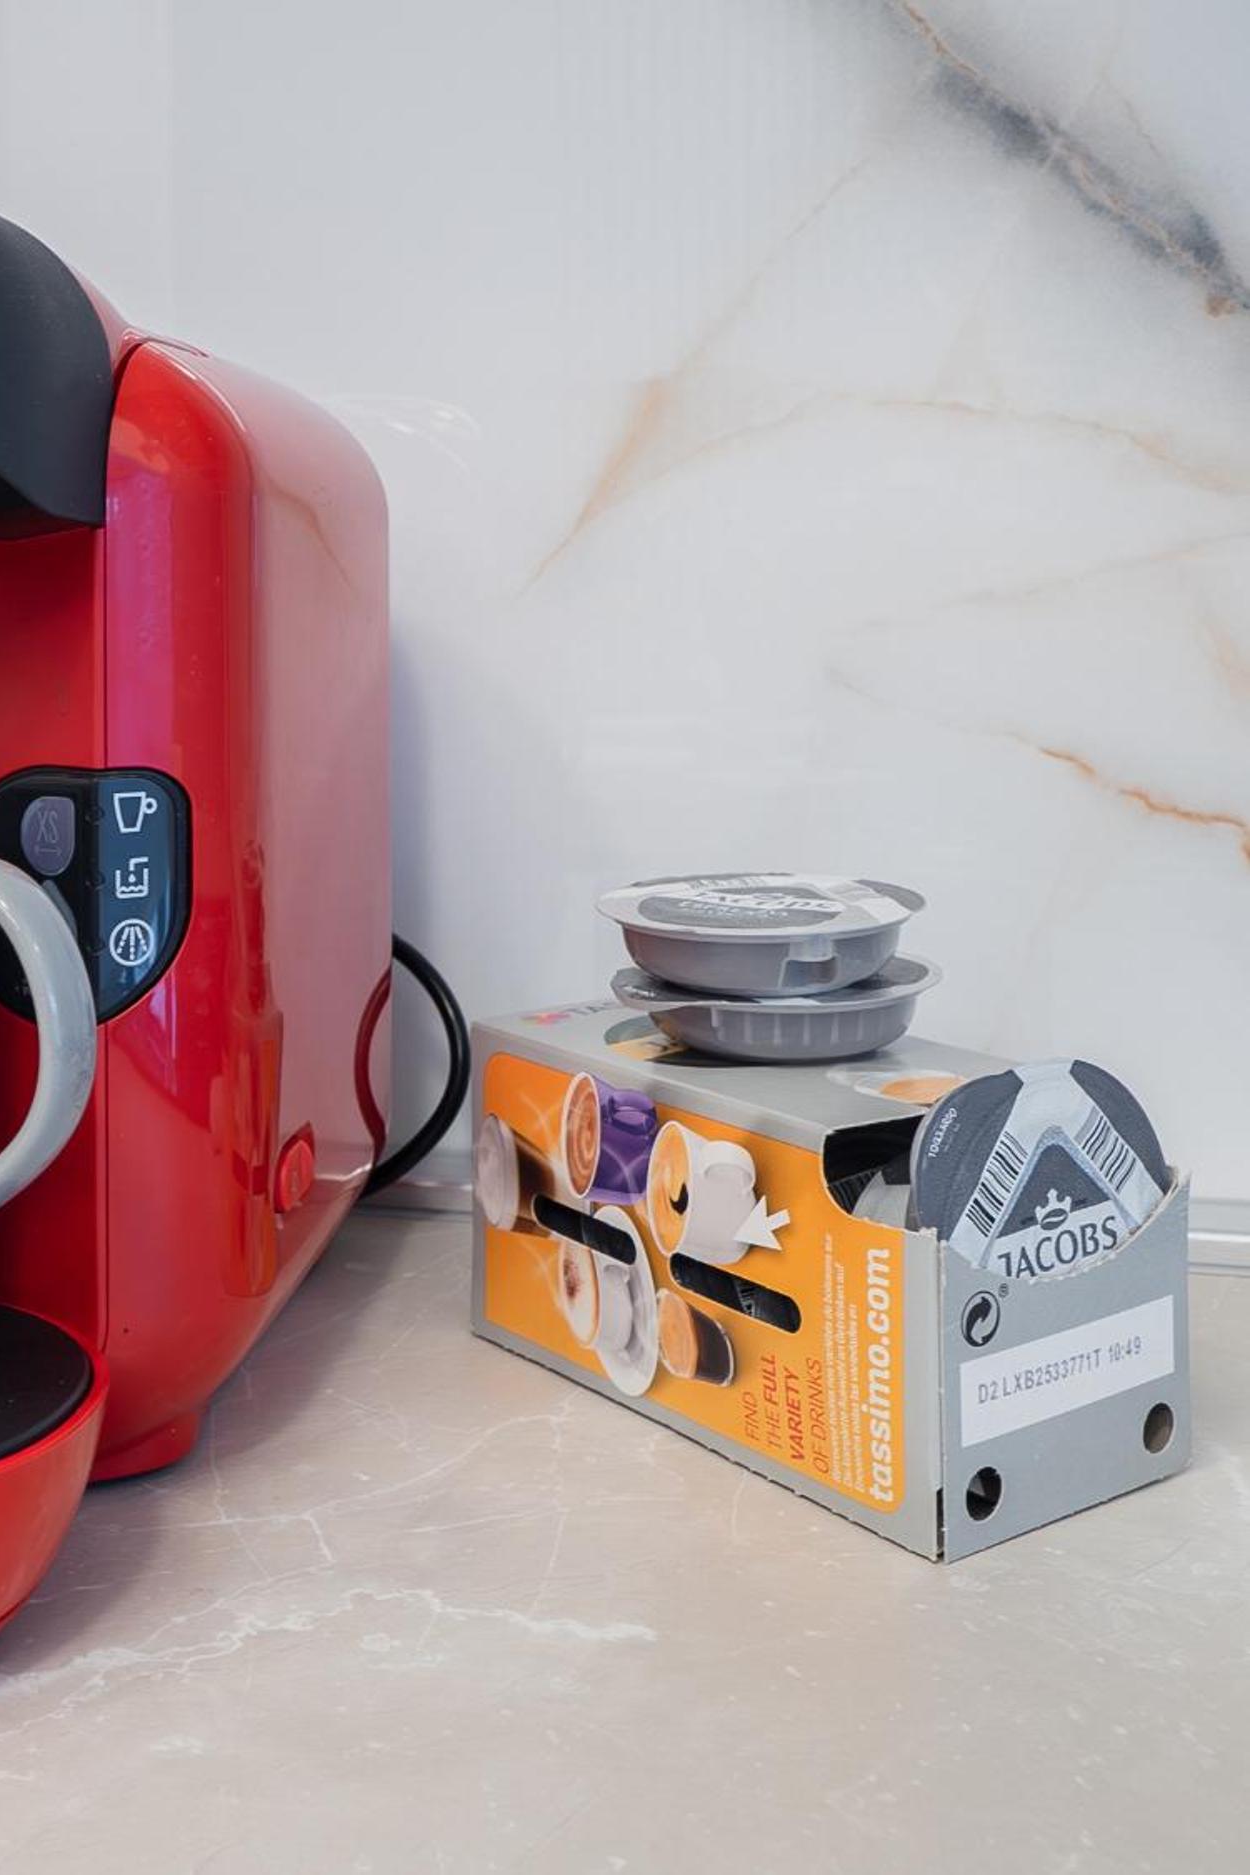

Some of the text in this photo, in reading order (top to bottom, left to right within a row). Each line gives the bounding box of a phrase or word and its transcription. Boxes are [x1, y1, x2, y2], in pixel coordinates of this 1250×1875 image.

[37, 809, 60, 844] XS
[997, 1215, 1118, 1279] JACOBS
[742, 1391, 759, 1441] FIND
[760, 1354, 782, 1449] THE FULL
[784, 1366, 805, 1460] VARIETY
[806, 1357, 830, 1474] OF DRINKS
[861, 1249, 894, 1501] tassimo.com
